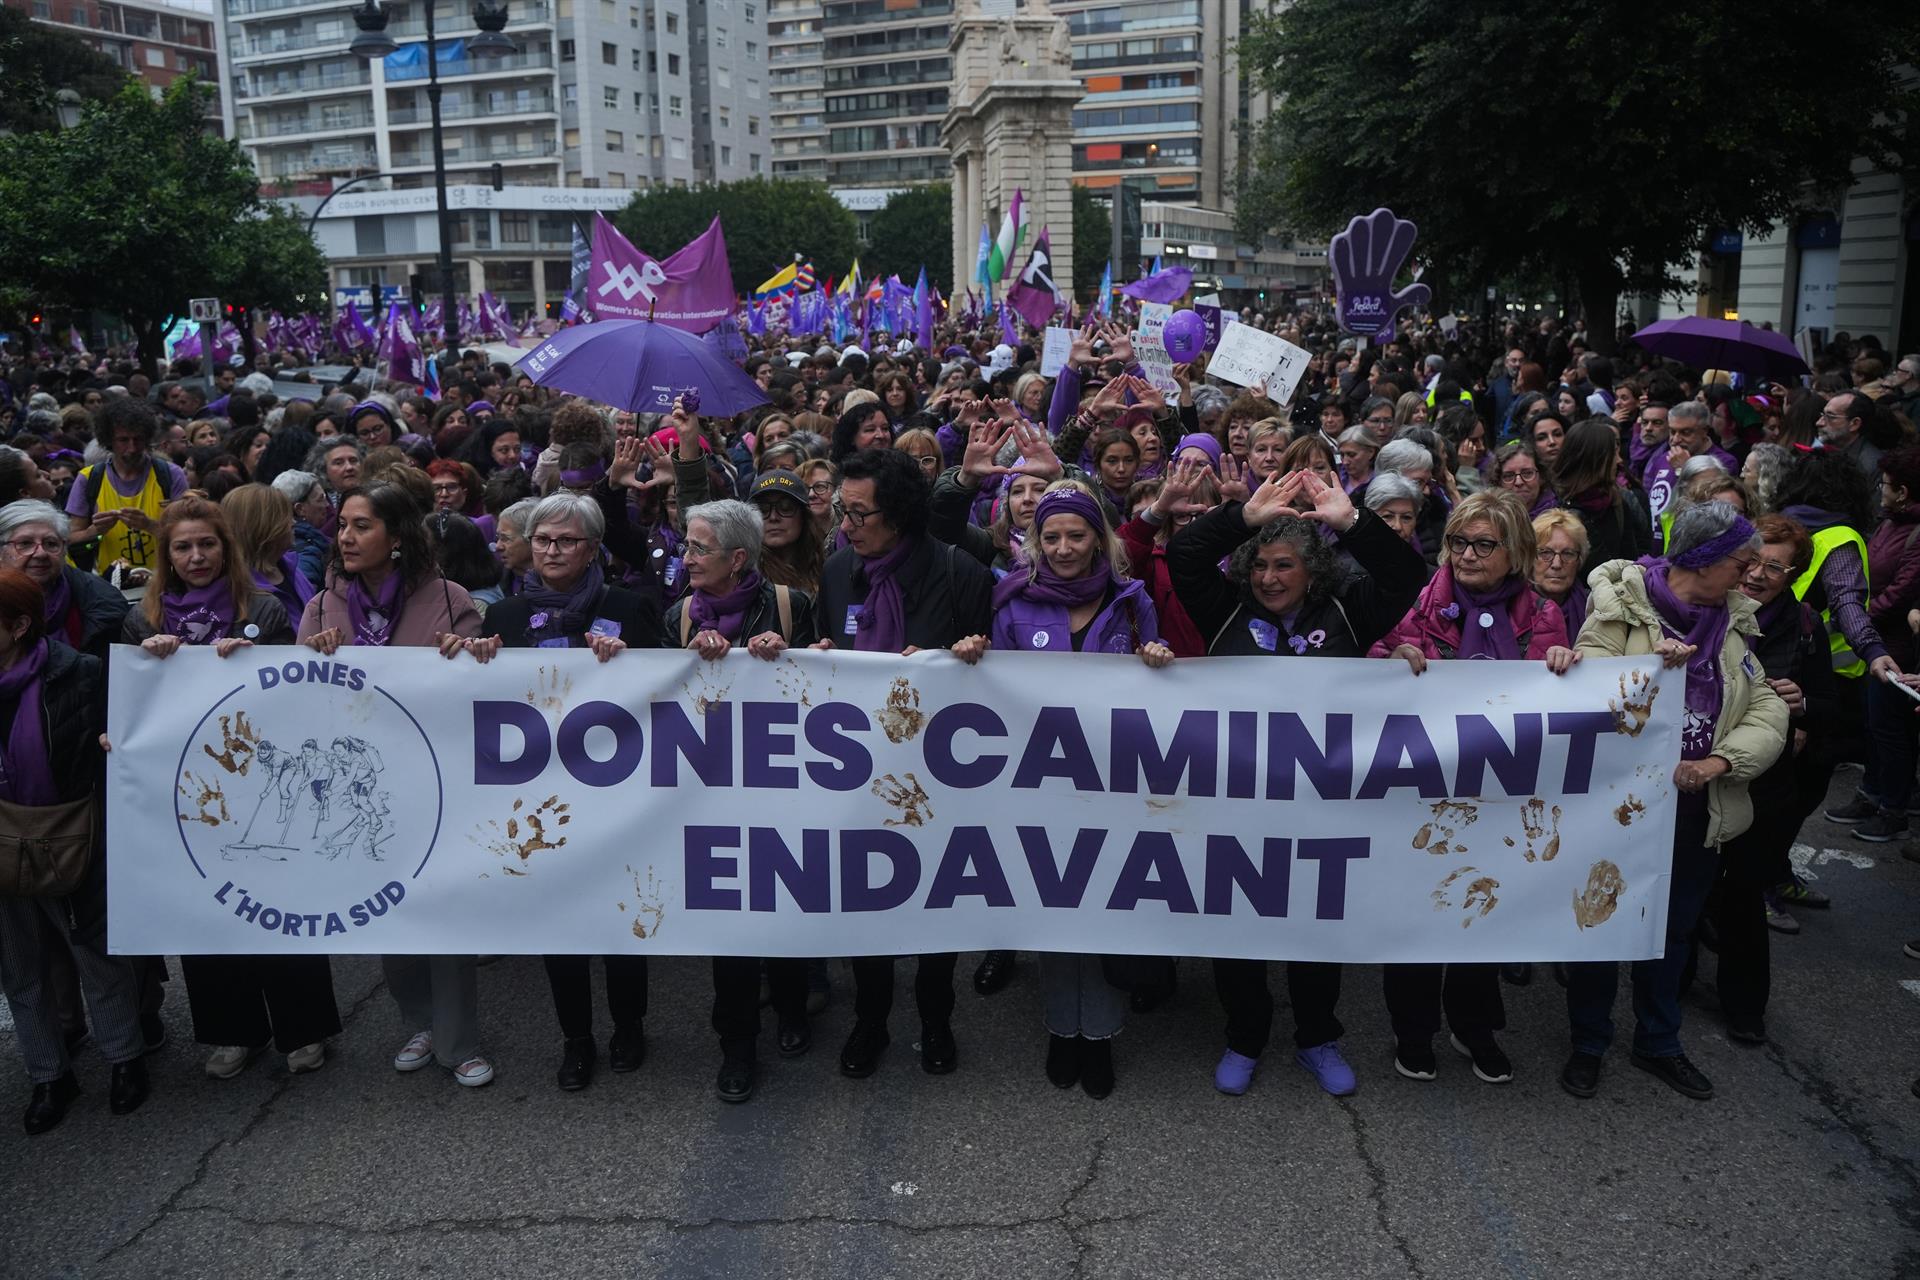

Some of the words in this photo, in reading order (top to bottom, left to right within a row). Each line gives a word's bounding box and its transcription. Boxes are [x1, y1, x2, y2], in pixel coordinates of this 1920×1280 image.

[595, 302, 633, 316] Women's
[633, 307, 682, 320] Decaration
[682, 307, 730, 320] International
[760, 477, 776, 489] NEW
[779, 476, 794, 488] DAY
[258, 660, 367, 691] DONES
[472, 700, 874, 792] DONES
[922, 702, 1618, 801] CAMINANT
[683, 825, 1371, 921] ENDAVANT
[349, 881, 406, 927] SUD
